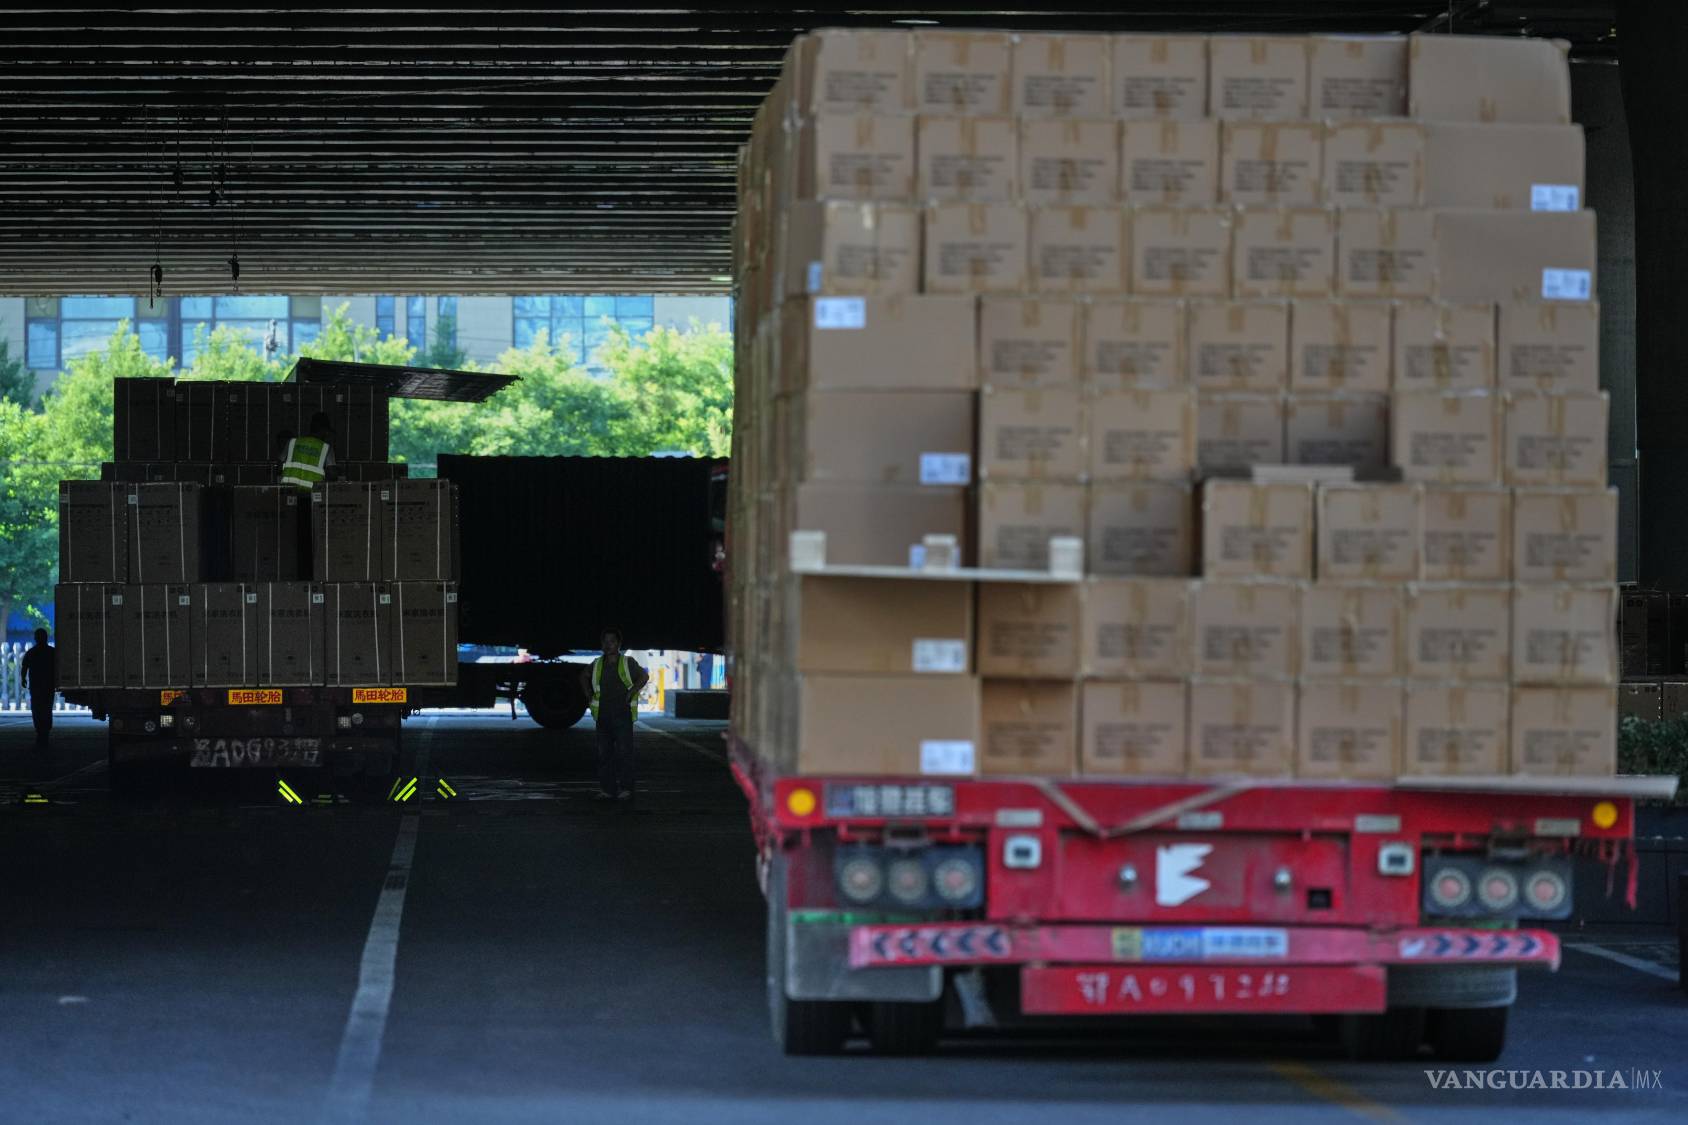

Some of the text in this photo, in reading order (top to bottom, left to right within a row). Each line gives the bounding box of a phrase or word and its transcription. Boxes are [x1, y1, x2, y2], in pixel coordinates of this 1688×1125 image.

[232, 690, 281, 703] 馬田轮胎
[354, 689, 404, 701] 馬田轮胎
